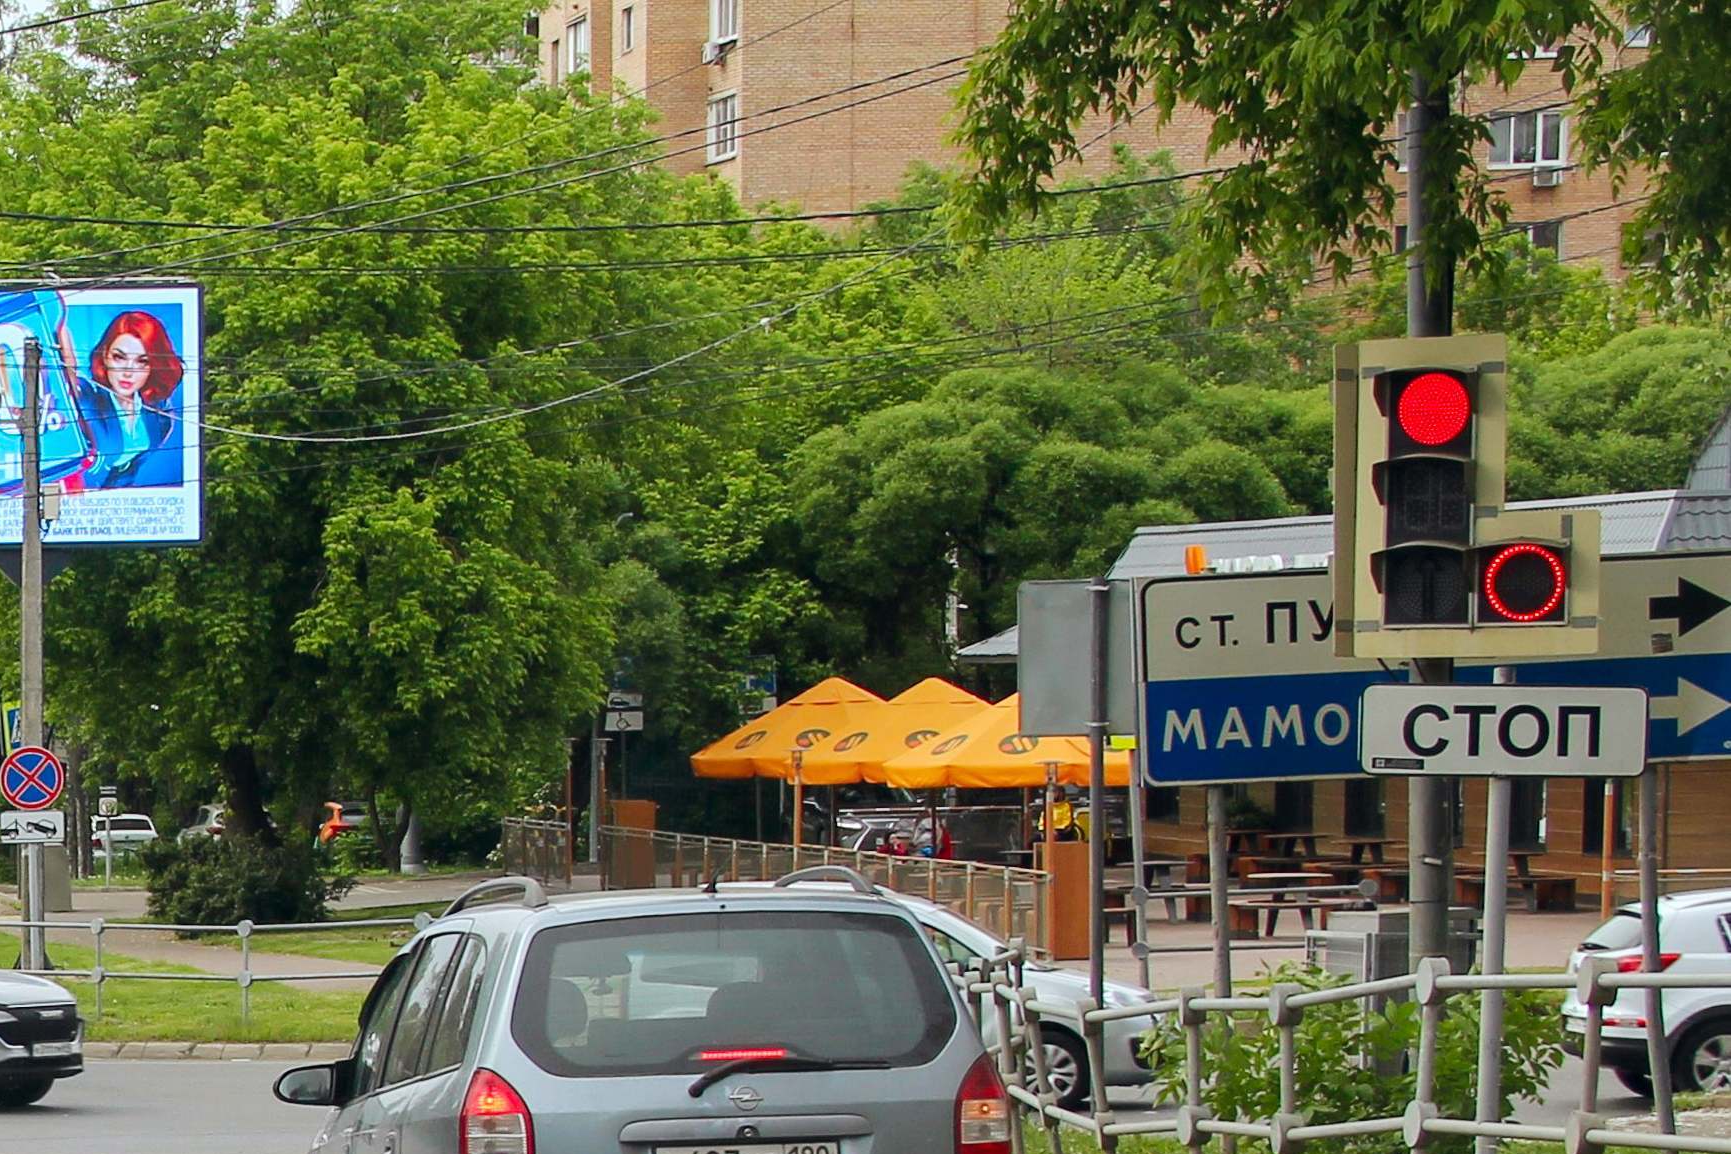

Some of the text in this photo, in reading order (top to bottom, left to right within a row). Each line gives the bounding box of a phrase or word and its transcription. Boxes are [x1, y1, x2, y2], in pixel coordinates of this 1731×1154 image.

[1266, 600, 1335, 643] ПУ
[1163, 703, 1351, 752] МАМО
[1402, 704, 1601, 758] СТОП
